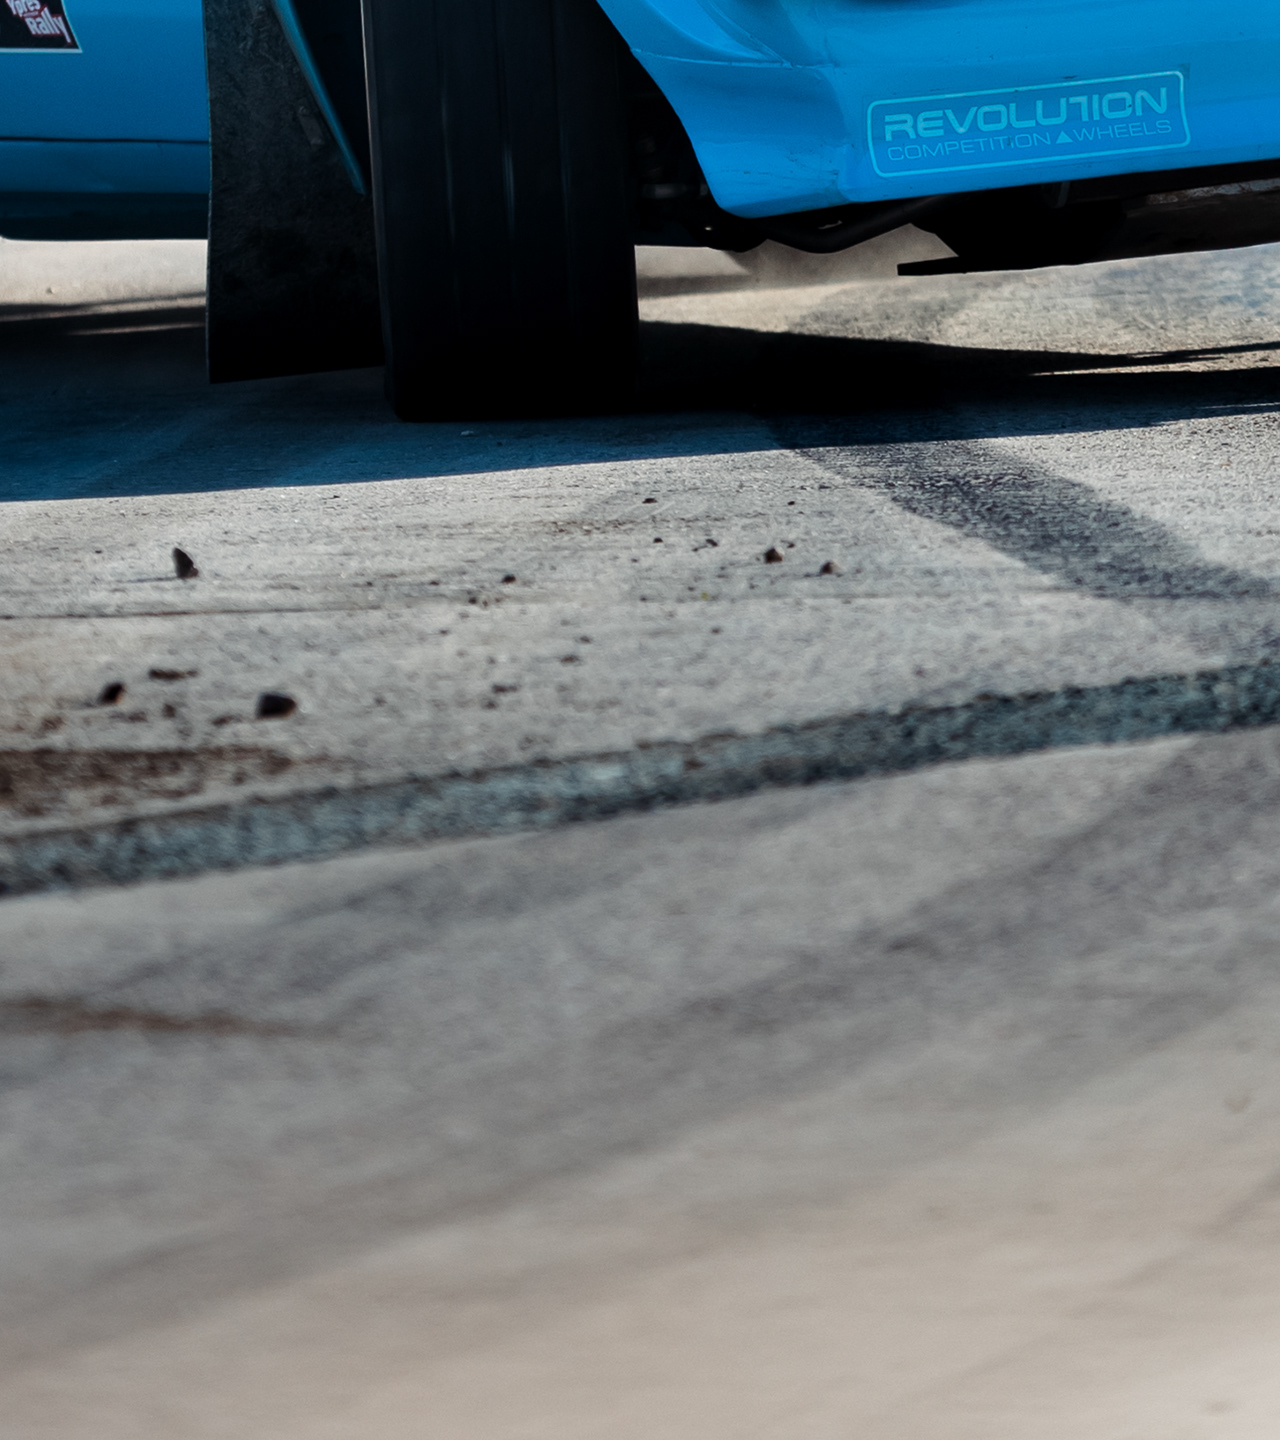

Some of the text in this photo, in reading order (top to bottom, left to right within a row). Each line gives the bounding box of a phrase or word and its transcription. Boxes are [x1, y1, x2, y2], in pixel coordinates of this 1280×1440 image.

[25, 6, 71, 43] Rally
[884, 87, 1168, 142] REVOLUTION
[887, 119, 1172, 161] COMPETITION WHEELS
